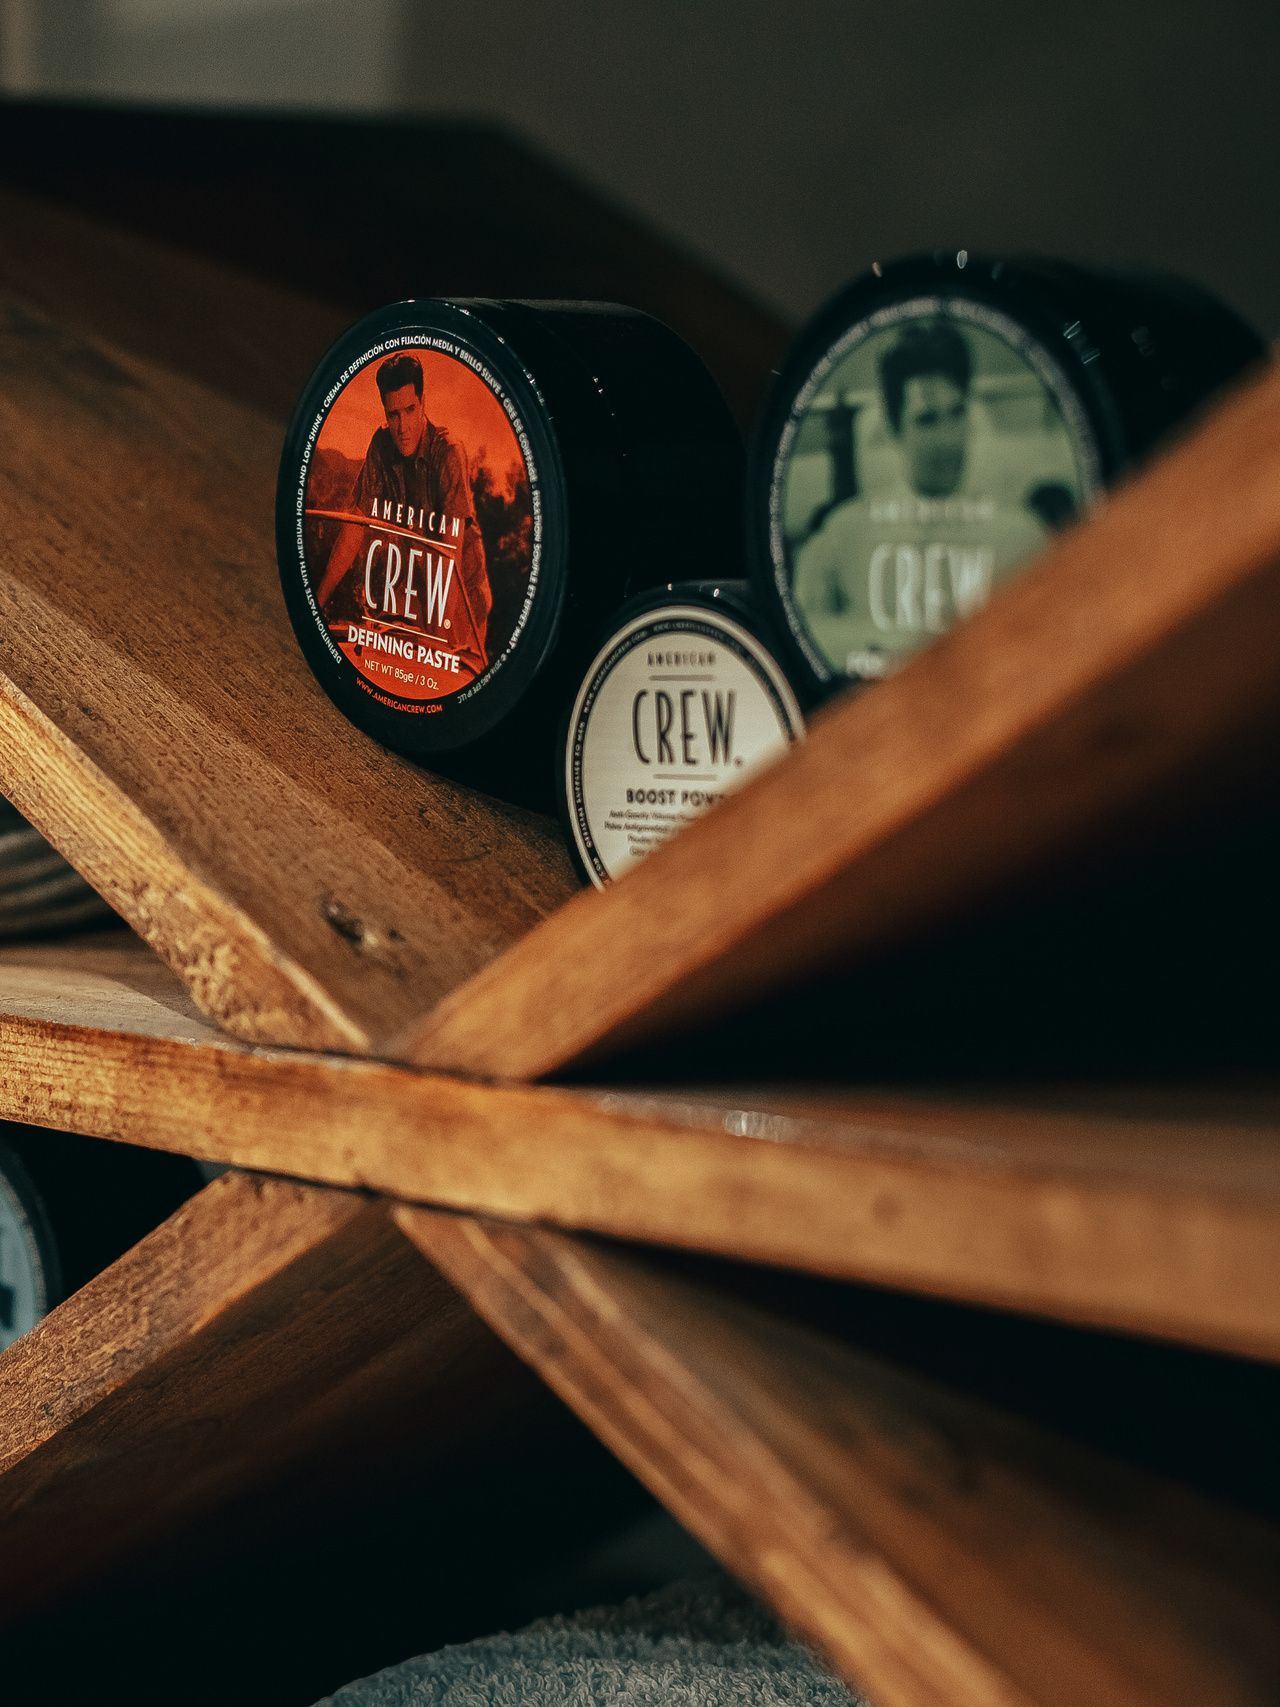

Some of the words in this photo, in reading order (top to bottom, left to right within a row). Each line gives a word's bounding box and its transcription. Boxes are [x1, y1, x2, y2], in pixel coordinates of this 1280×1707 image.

[323, 381, 342, 408] CREMA
[340, 371, 350, 384] DE
[348, 344, 384, 375] DEFINICIÓN
[384, 338, 400, 350] CON
[401, 334, 431, 346] FIJACIÓN
[432, 338, 454, 353] MEDIA
[454, 345, 460, 356] Y
[460, 349, 483, 372] BRILLO
[480, 367, 502, 394] SUAVE
[308, 413, 323, 442] SHINE
[513, 418, 524, 434] DE
[303, 441, 312, 464] LOW
[299, 464, 307, 487] AND
[296, 490, 304, 517] HOLD
[371, 497, 460, 537] AMERICAN
[296, 518, 305, 559] MEDIUM
[300, 561, 309, 587] WITH
[305, 587, 318, 616] PASTE
[315, 616, 342, 664] DEFINITION
[347, 625, 414, 660] DEFINING
[417, 644, 460, 674] PASTE
[508, 626, 521, 649] MAT
[364, 659, 380, 672] NET
[381, 663, 393, 676] WT
[420, 675, 425, 686] 3
[356, 677, 442, 714] WWW.AMERICANCREW.COM
[626, 788, 676, 805] BOOST
